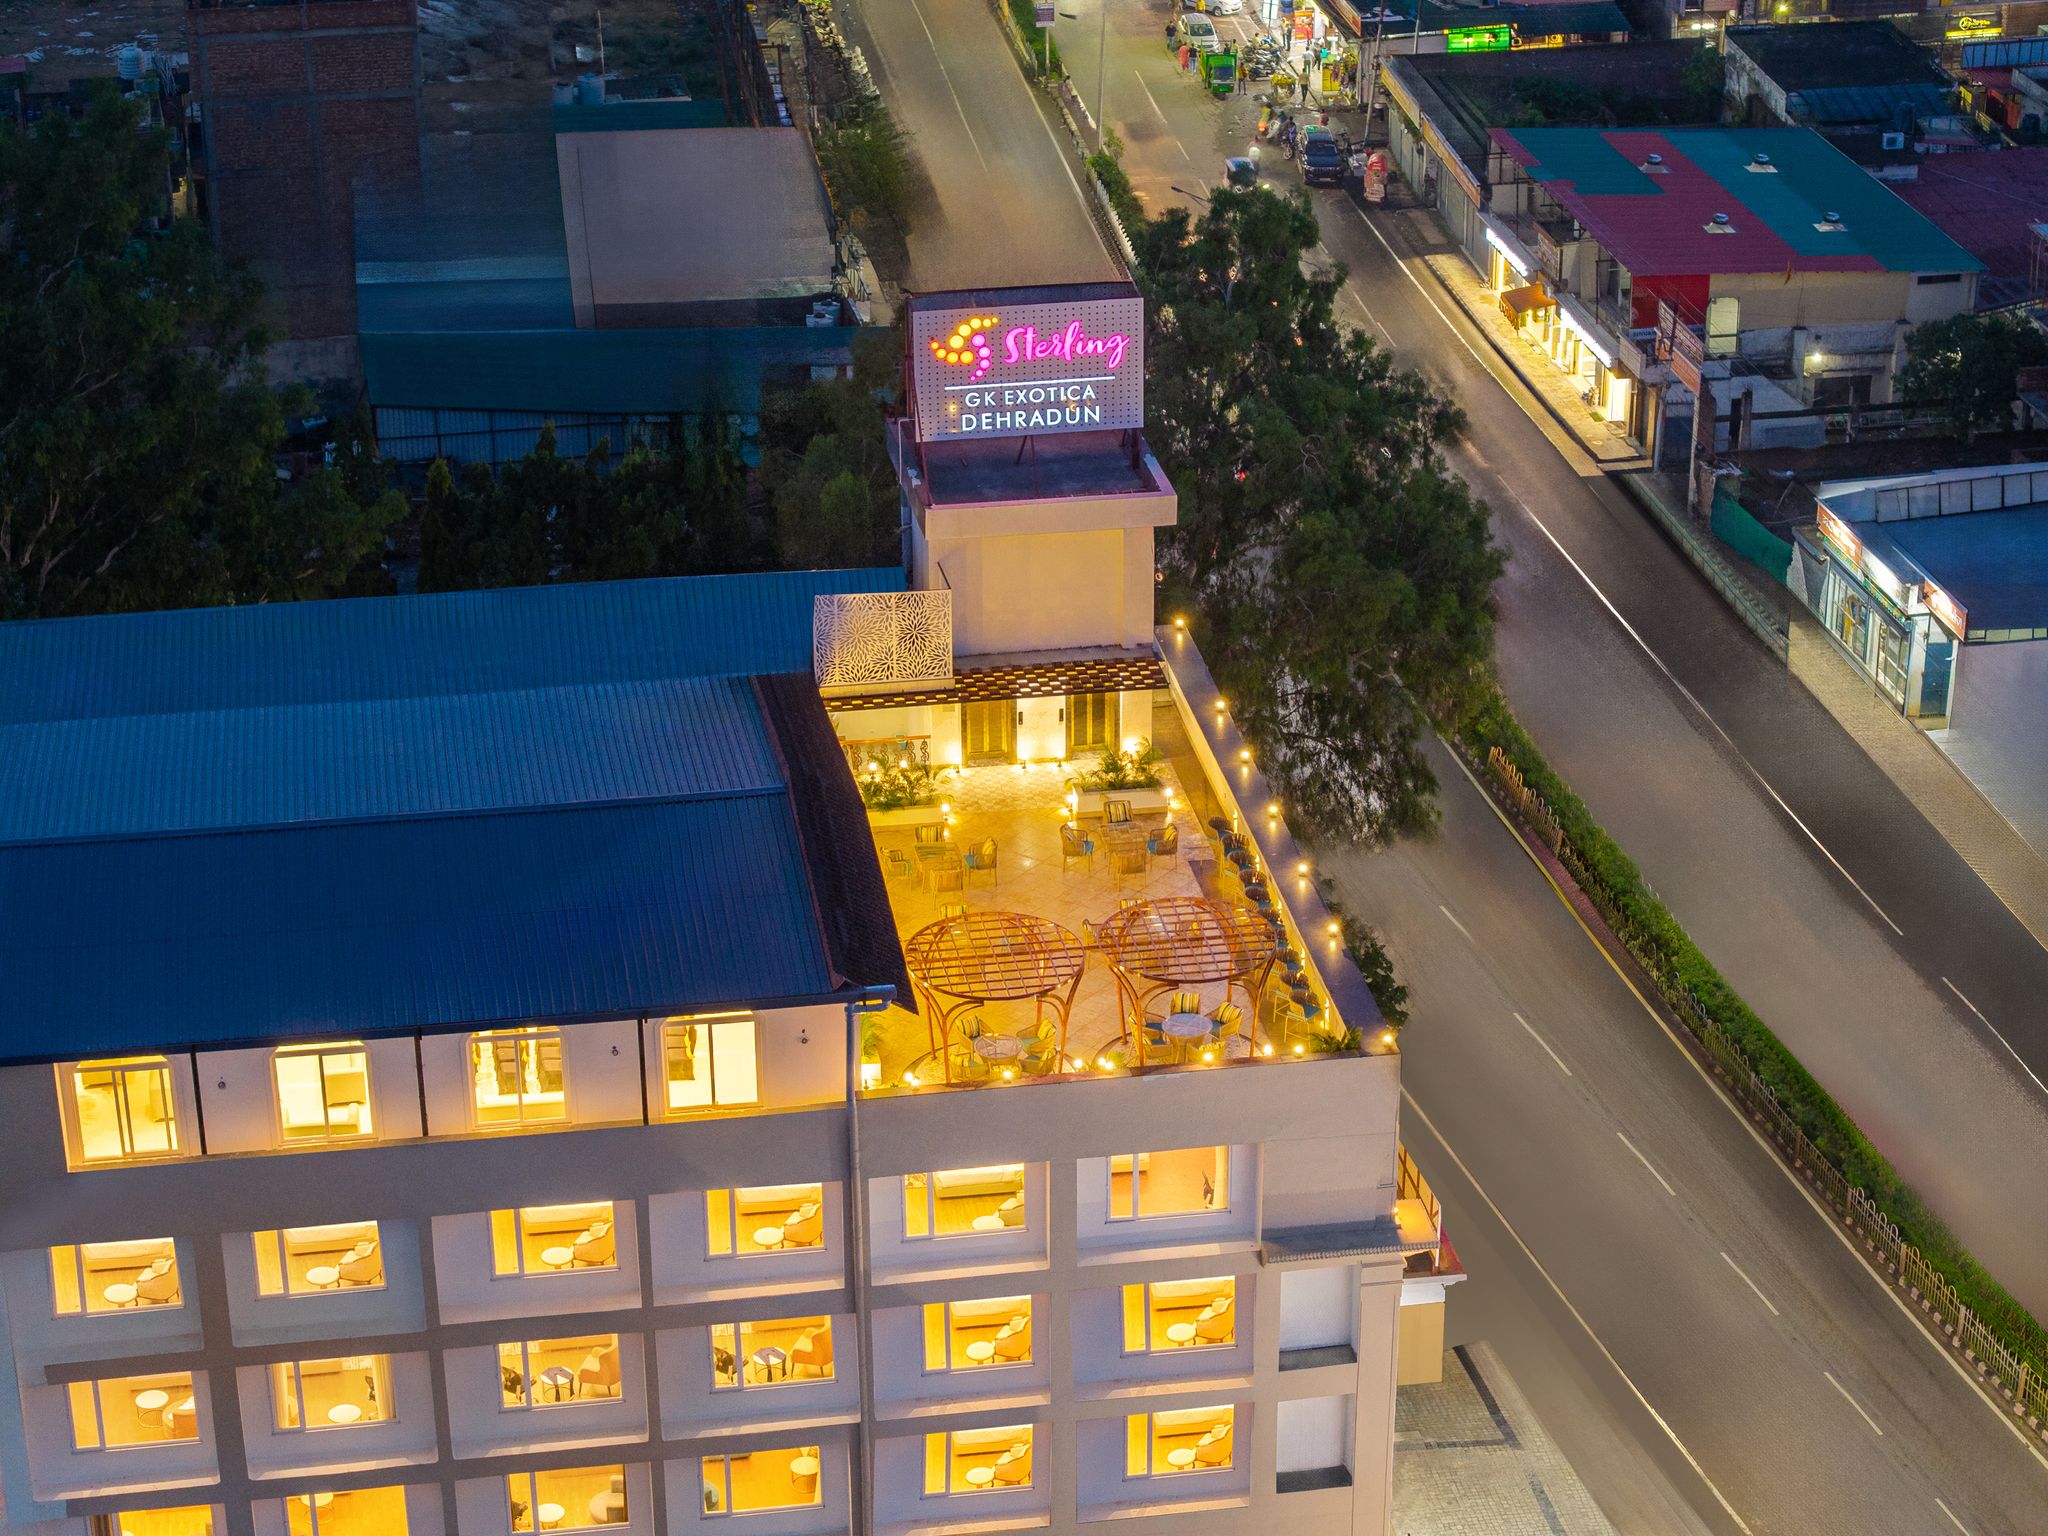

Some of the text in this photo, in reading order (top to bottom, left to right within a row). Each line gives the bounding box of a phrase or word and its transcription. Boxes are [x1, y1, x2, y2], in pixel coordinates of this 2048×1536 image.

[1004, 320, 1130, 369] Sterling
[965, 384, 1096, 408] GK EXOTICA
[961, 406, 1100, 432] DEHRADUN
